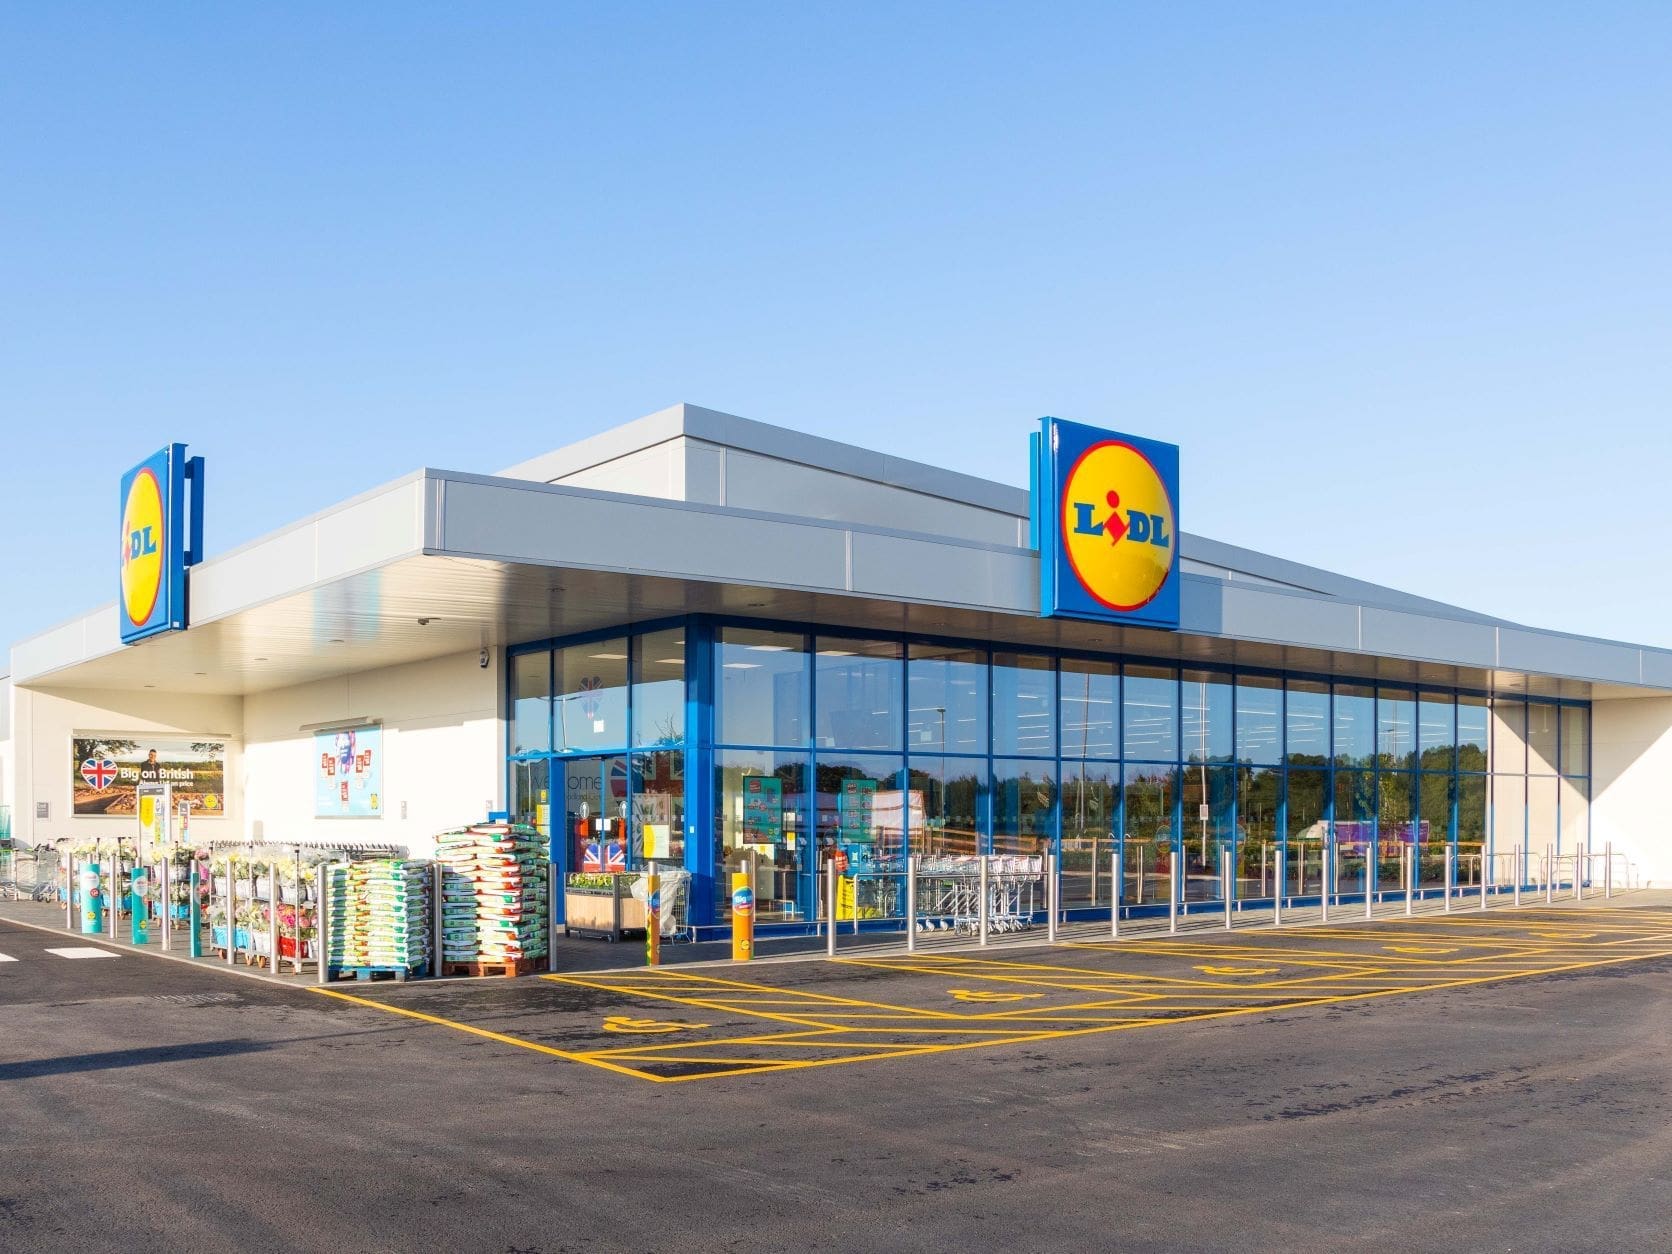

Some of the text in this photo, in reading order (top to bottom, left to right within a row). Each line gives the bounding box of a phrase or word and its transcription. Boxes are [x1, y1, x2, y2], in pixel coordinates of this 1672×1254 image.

[121, 768, 193, 780] Big on British
